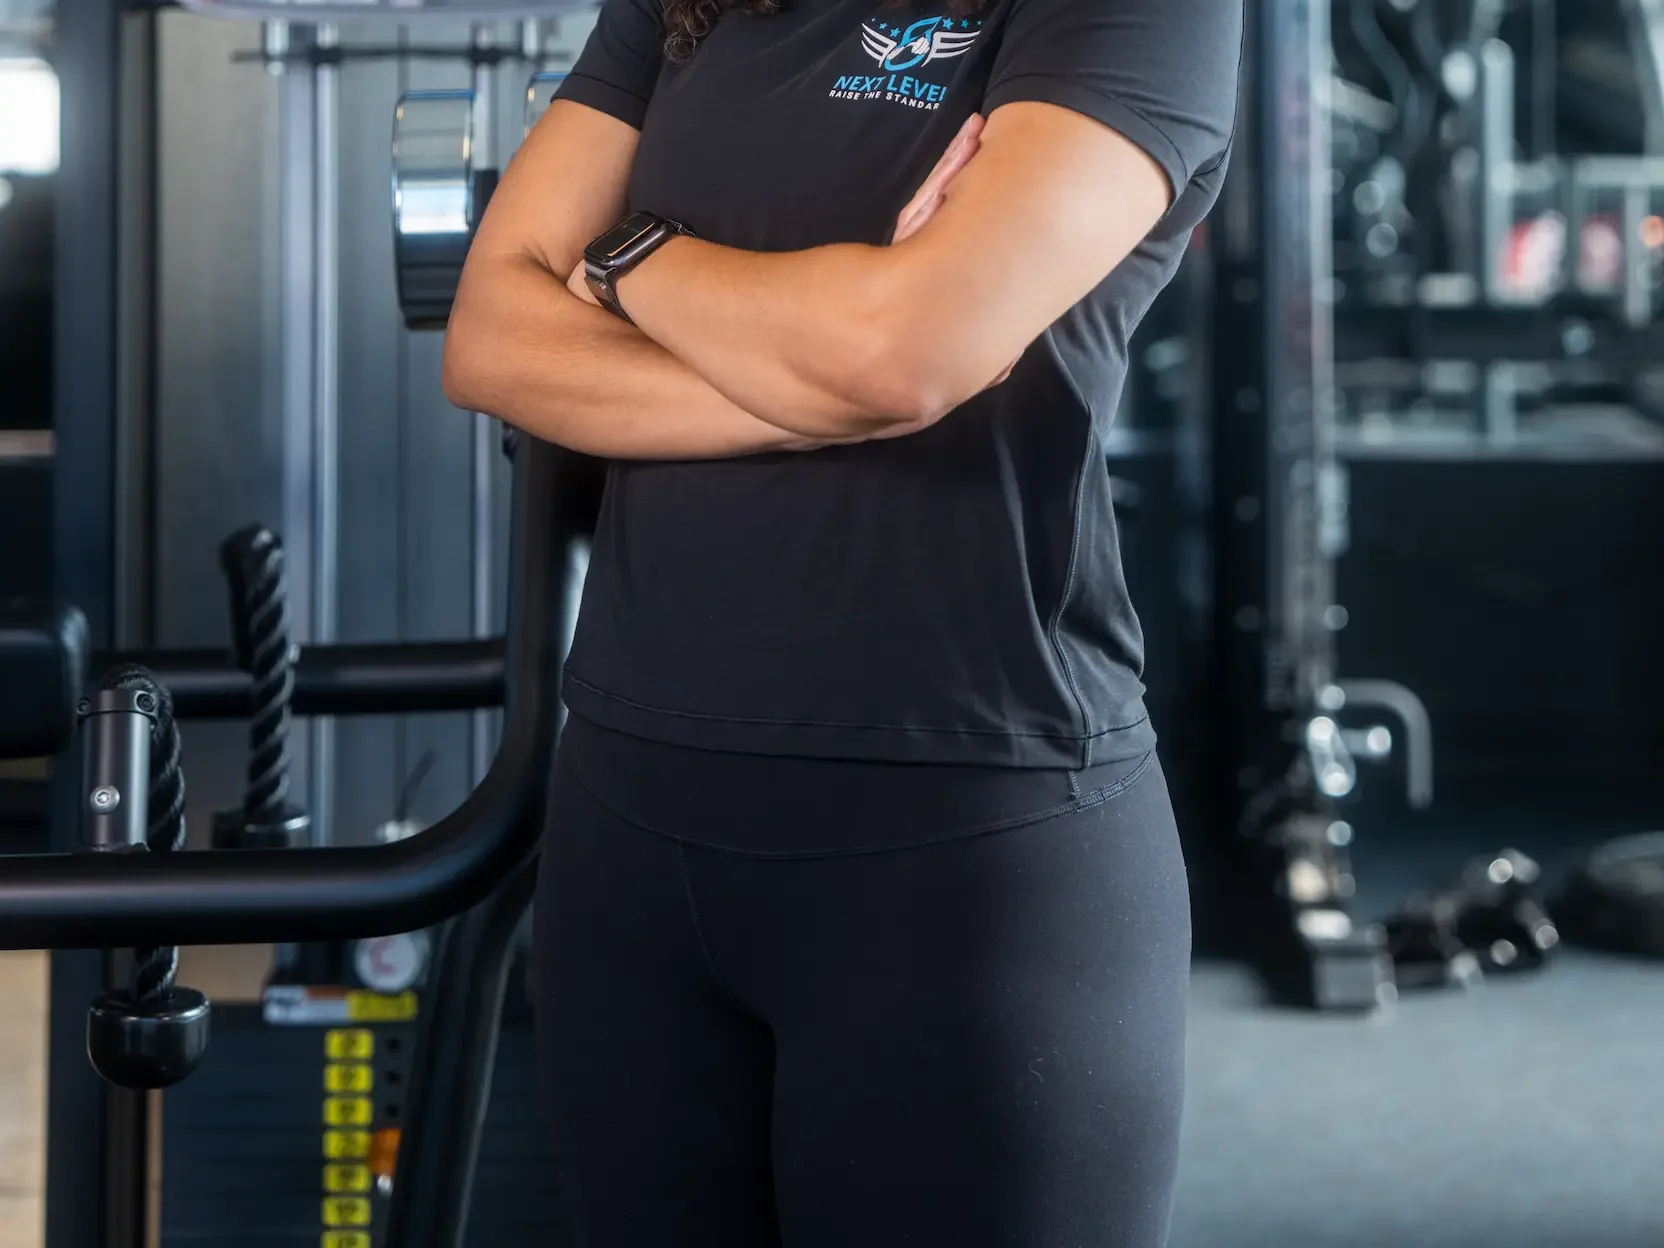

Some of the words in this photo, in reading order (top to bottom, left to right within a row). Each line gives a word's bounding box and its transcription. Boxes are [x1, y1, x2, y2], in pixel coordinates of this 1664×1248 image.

[833, 75, 887, 93] NEXT
[829, 89, 861, 100] RAISE
[863, 90, 881, 99] THE
[885, 91, 940, 110] STANDAR
